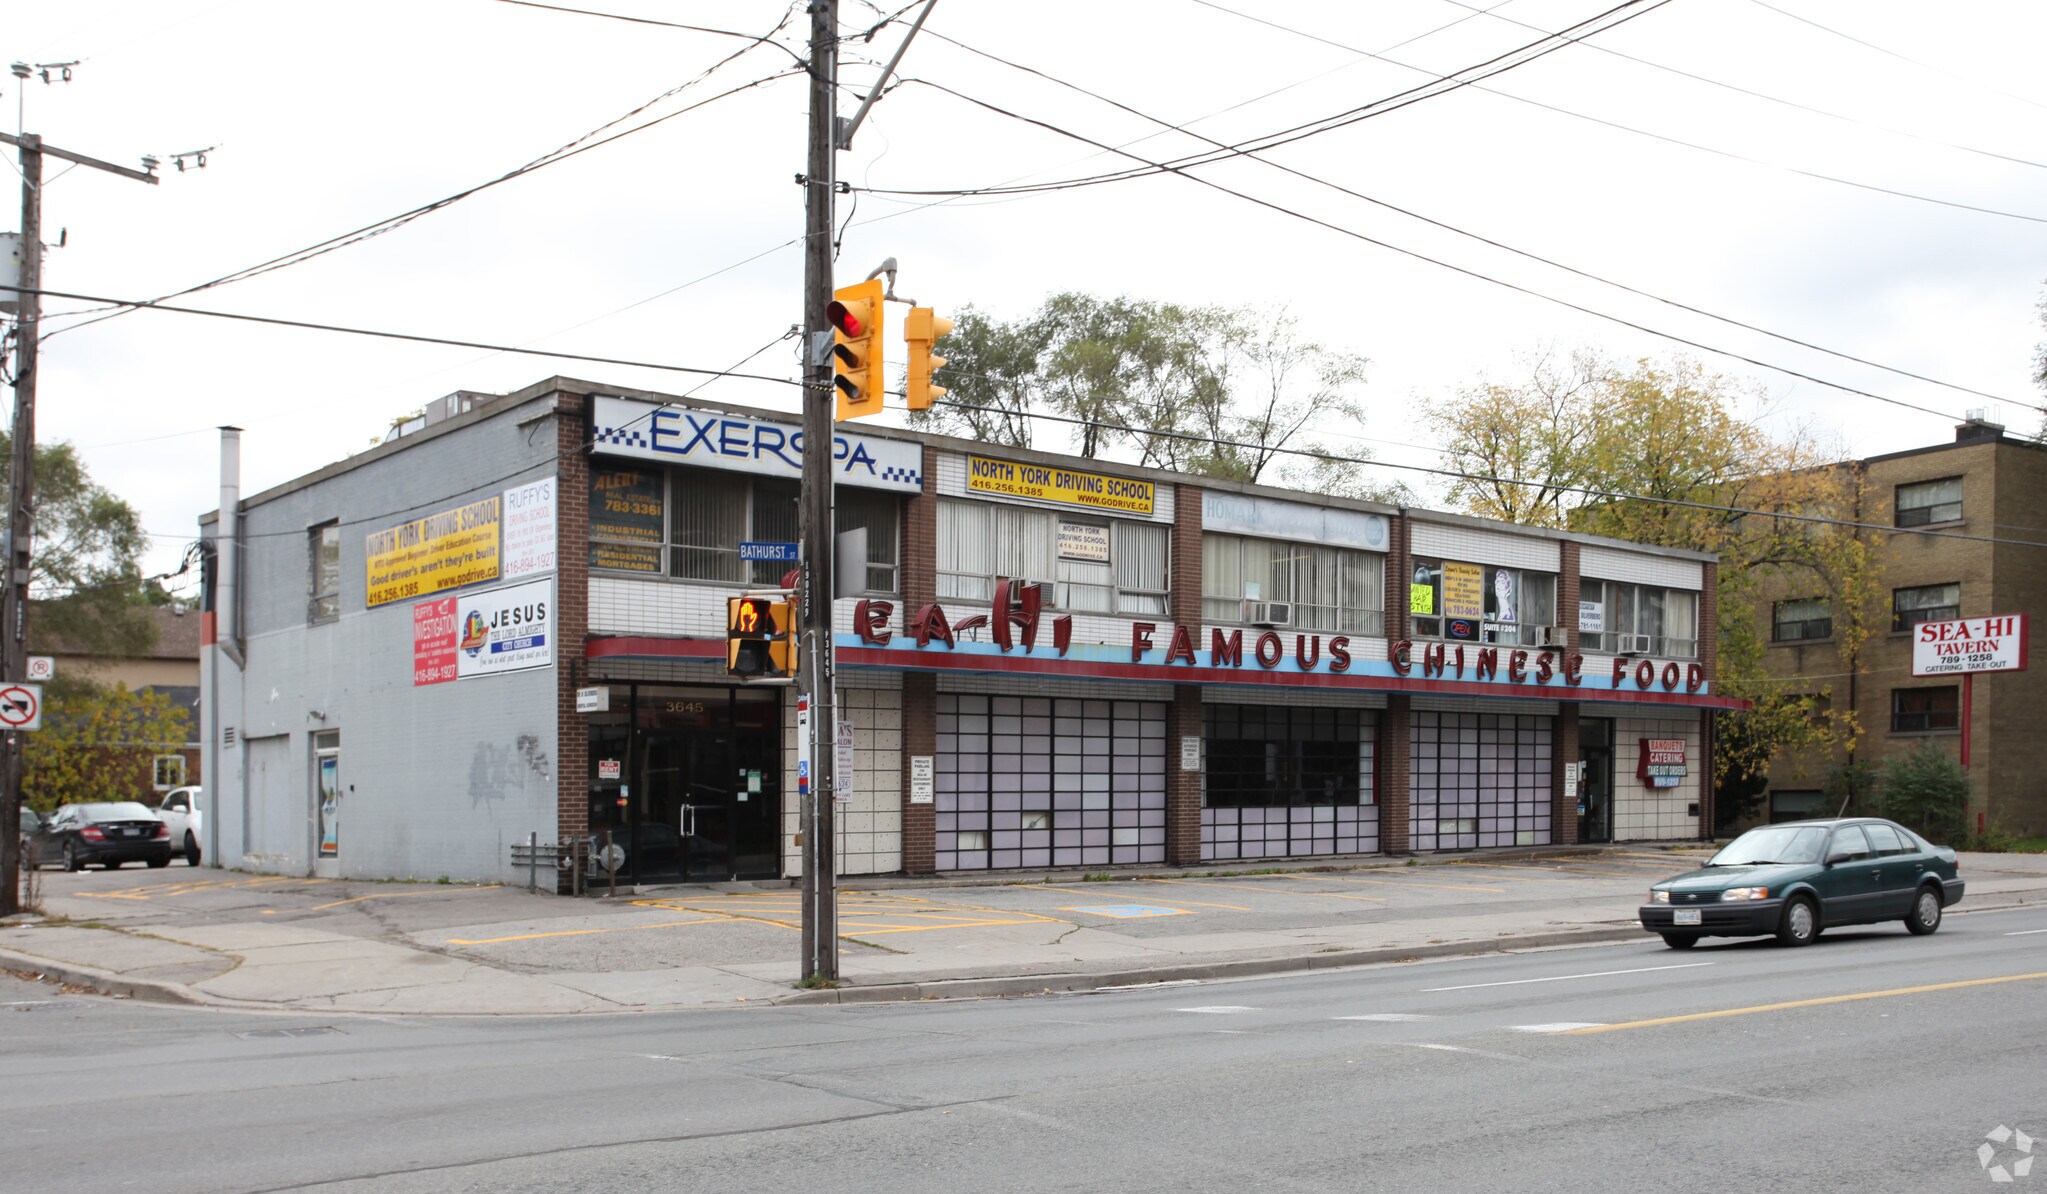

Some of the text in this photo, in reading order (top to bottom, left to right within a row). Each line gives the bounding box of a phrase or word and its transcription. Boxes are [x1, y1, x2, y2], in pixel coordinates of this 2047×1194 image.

[972, 460, 1151, 500] NORTH YORK DRIVING SCHOOL
[972, 479, 1043, 497] 416.256.1385
[509, 483, 550, 509] RUFFY'S
[1077, 494, 1149, 511] WWW.GODRIVE.CA
[1206, 499, 1265, 524] HOMARK
[367, 500, 498, 558] NORTH YORK DRIVING SCHOOL
[596, 524, 660, 537] INDUSTRIAL
[1062, 524, 1100, 535] NORTH YORK
[1057, 533, 1106, 545] DRIVING SCHOOL
[1059, 542, 1107, 553] 416.256.1385
[597, 550, 659, 563] RESIDENTIAL
[740, 545, 785, 559] BATHURST
[370, 546, 496, 586] Good driver's aren't they're built
[504, 551, 555, 576] 416-894-1927
[597, 559, 655, 571] MORTGAGES
[368, 566, 498, 604] 416.256.1385 www.godrive.ca
[491, 602, 546, 628] JESUS
[415, 613, 457, 640] INVESTIGATION
[491, 623, 545, 642] THE LORD ALMIGHTY
[1484, 623, 1517, 633] SUITE #204
[1920, 617, 2015, 643] SEA-HI
[1934, 639, 2000, 656] TAVERN
[1131, 622, 1351, 672] FAMOUS
[1391, 640, 1584, 686] CHINESE
[1612, 657, 1704, 693] FOOD
[1941, 653, 1993, 664] 789-1258
[415, 664, 456, 682] 416-894-1927
[1925, 660, 2007, 673] CATERING TAKE OUT
[666, 701, 704, 713] 3645
[1650, 740, 1684, 751] BANQUETS
[1650, 752, 1683, 763] CATERING
[1647, 765, 1686, 775] TAKE OUT ORDERS
